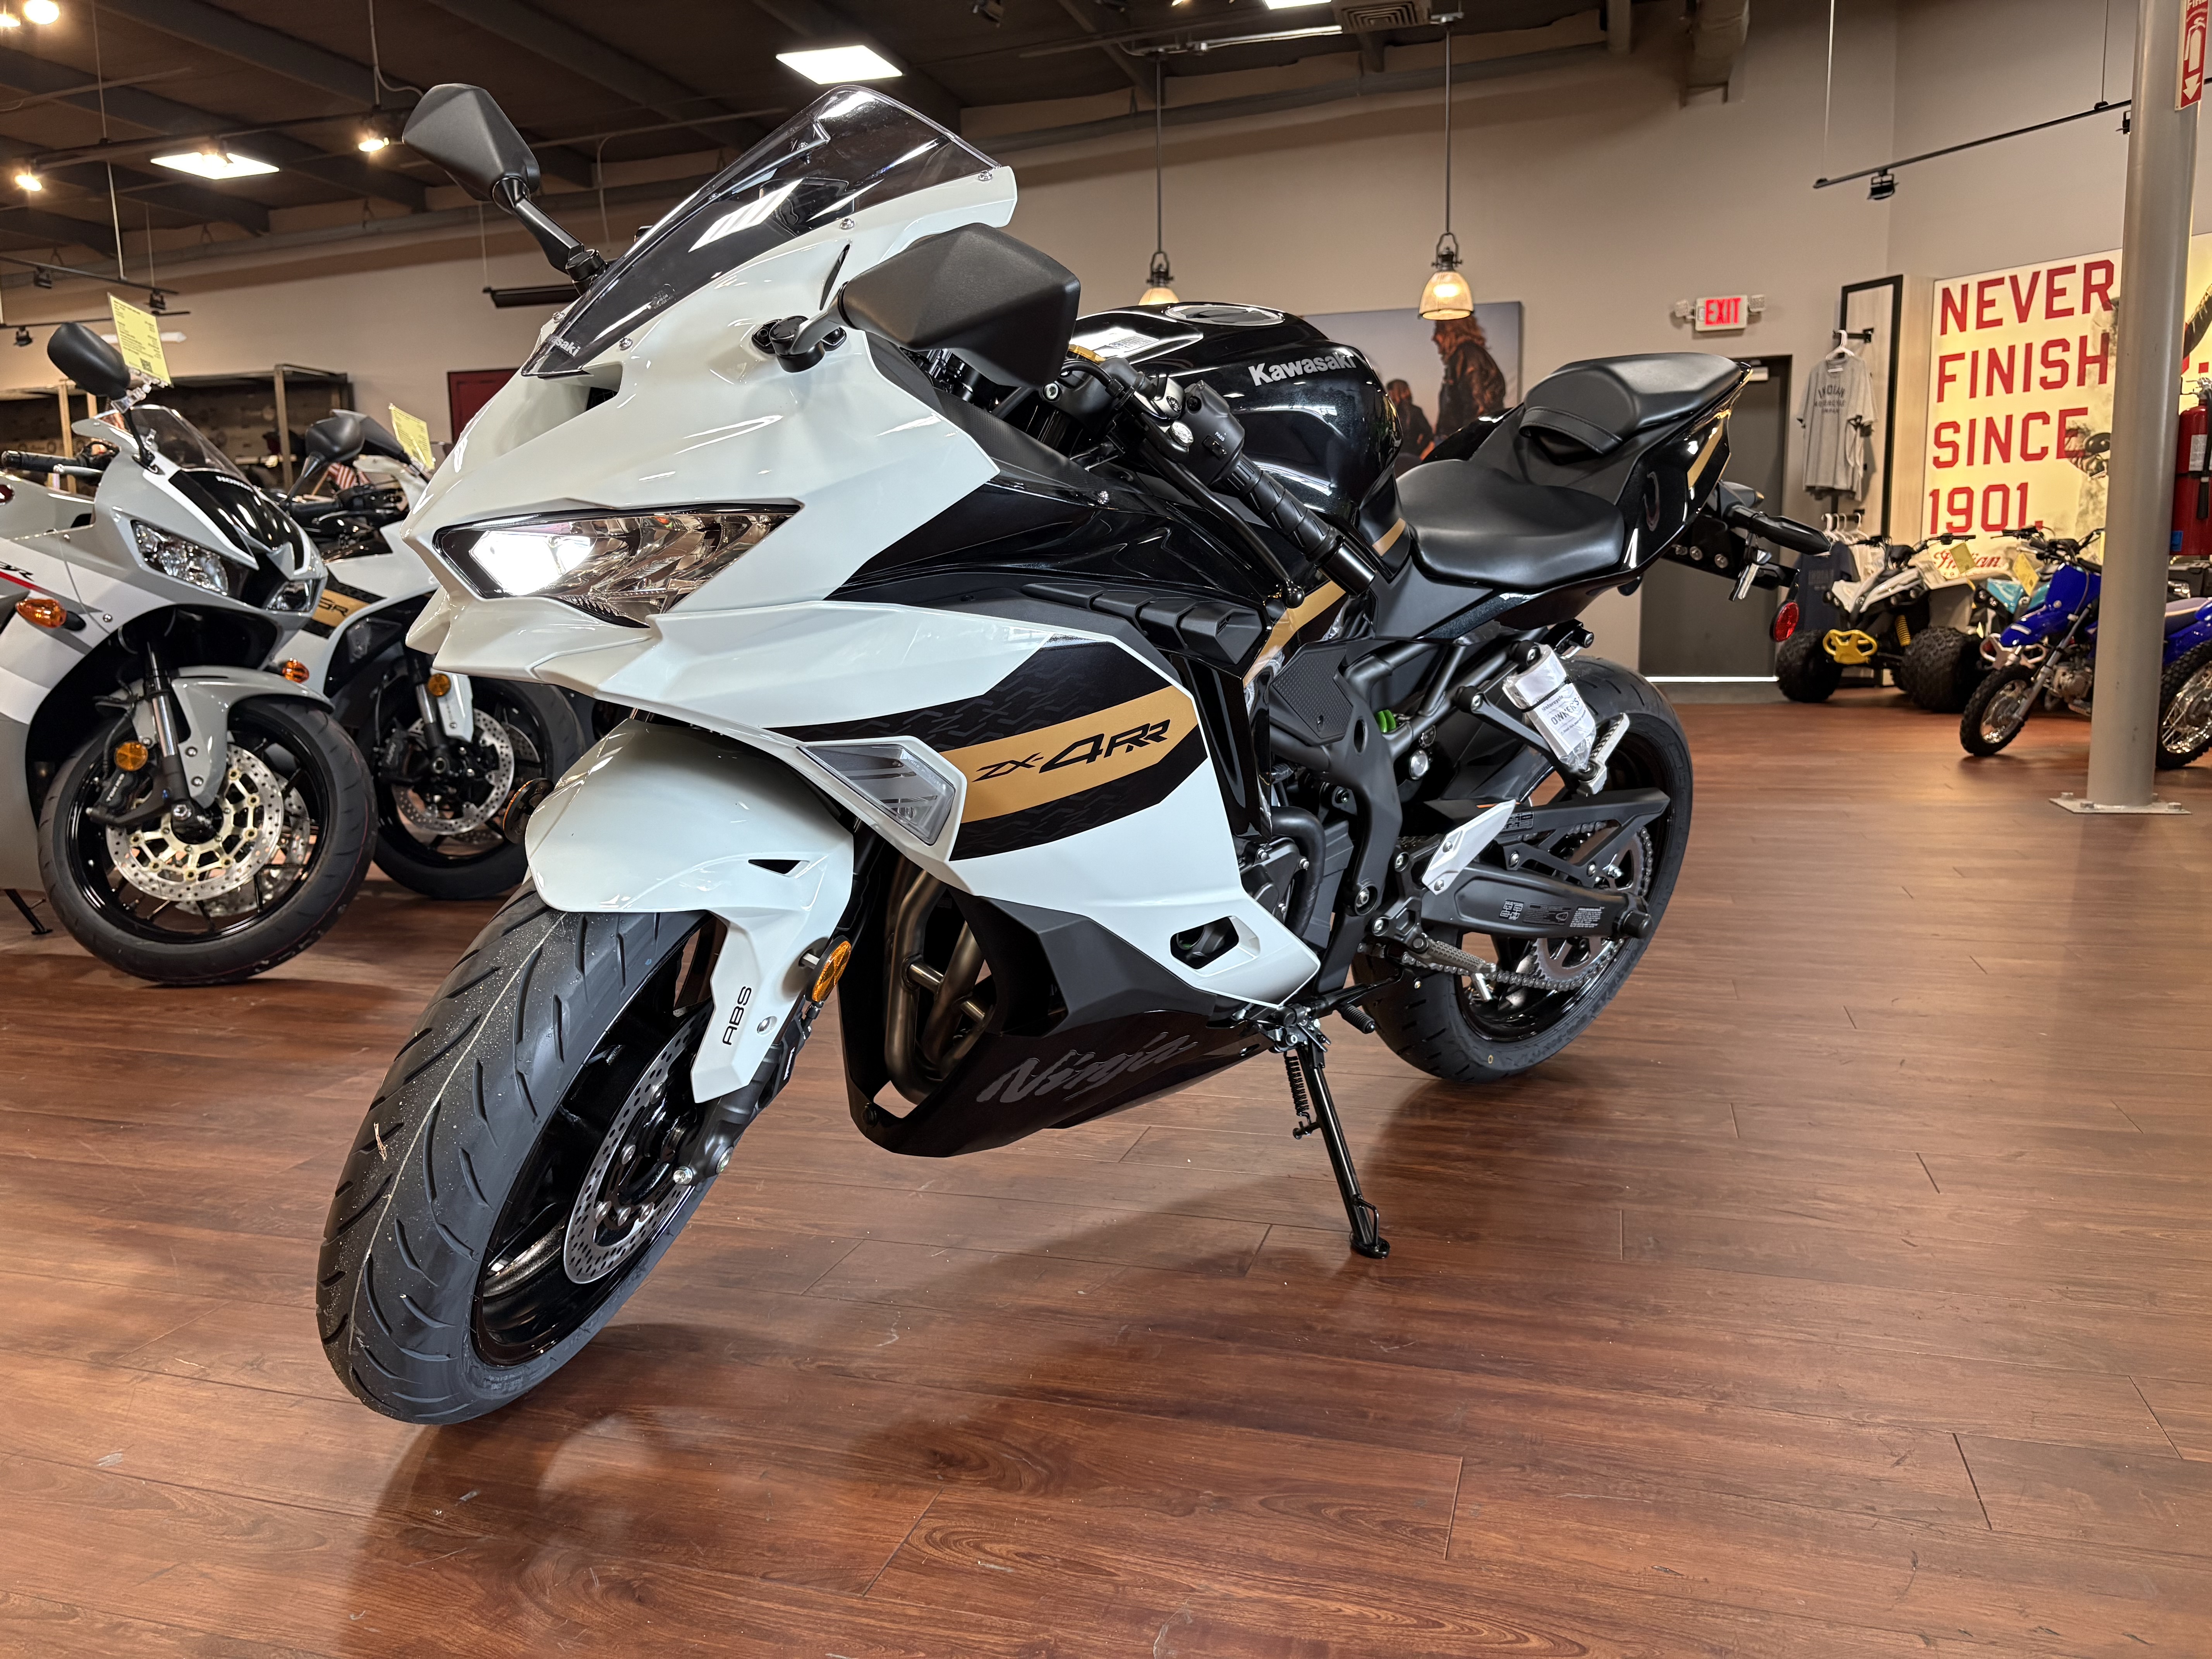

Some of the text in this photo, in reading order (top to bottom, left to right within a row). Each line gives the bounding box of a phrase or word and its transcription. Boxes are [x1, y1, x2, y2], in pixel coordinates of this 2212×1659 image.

[1705, 297, 1741, 326] EXIT
[1940, 259, 2114, 335] NEVER
[1248, 352, 1357, 386] Kawasaki
[1214, 431, 1225, 441] PASS
[1933, 407, 2088, 469] SINCE
[1929, 482, 2044, 535] 1901.
[1541, 695, 1564, 712] Motorcycle
[1551, 697, 1580, 725] OWNER'S
[722, 986, 752, 1046] ABS
[976, 1032, 1198, 1103] Ninja
